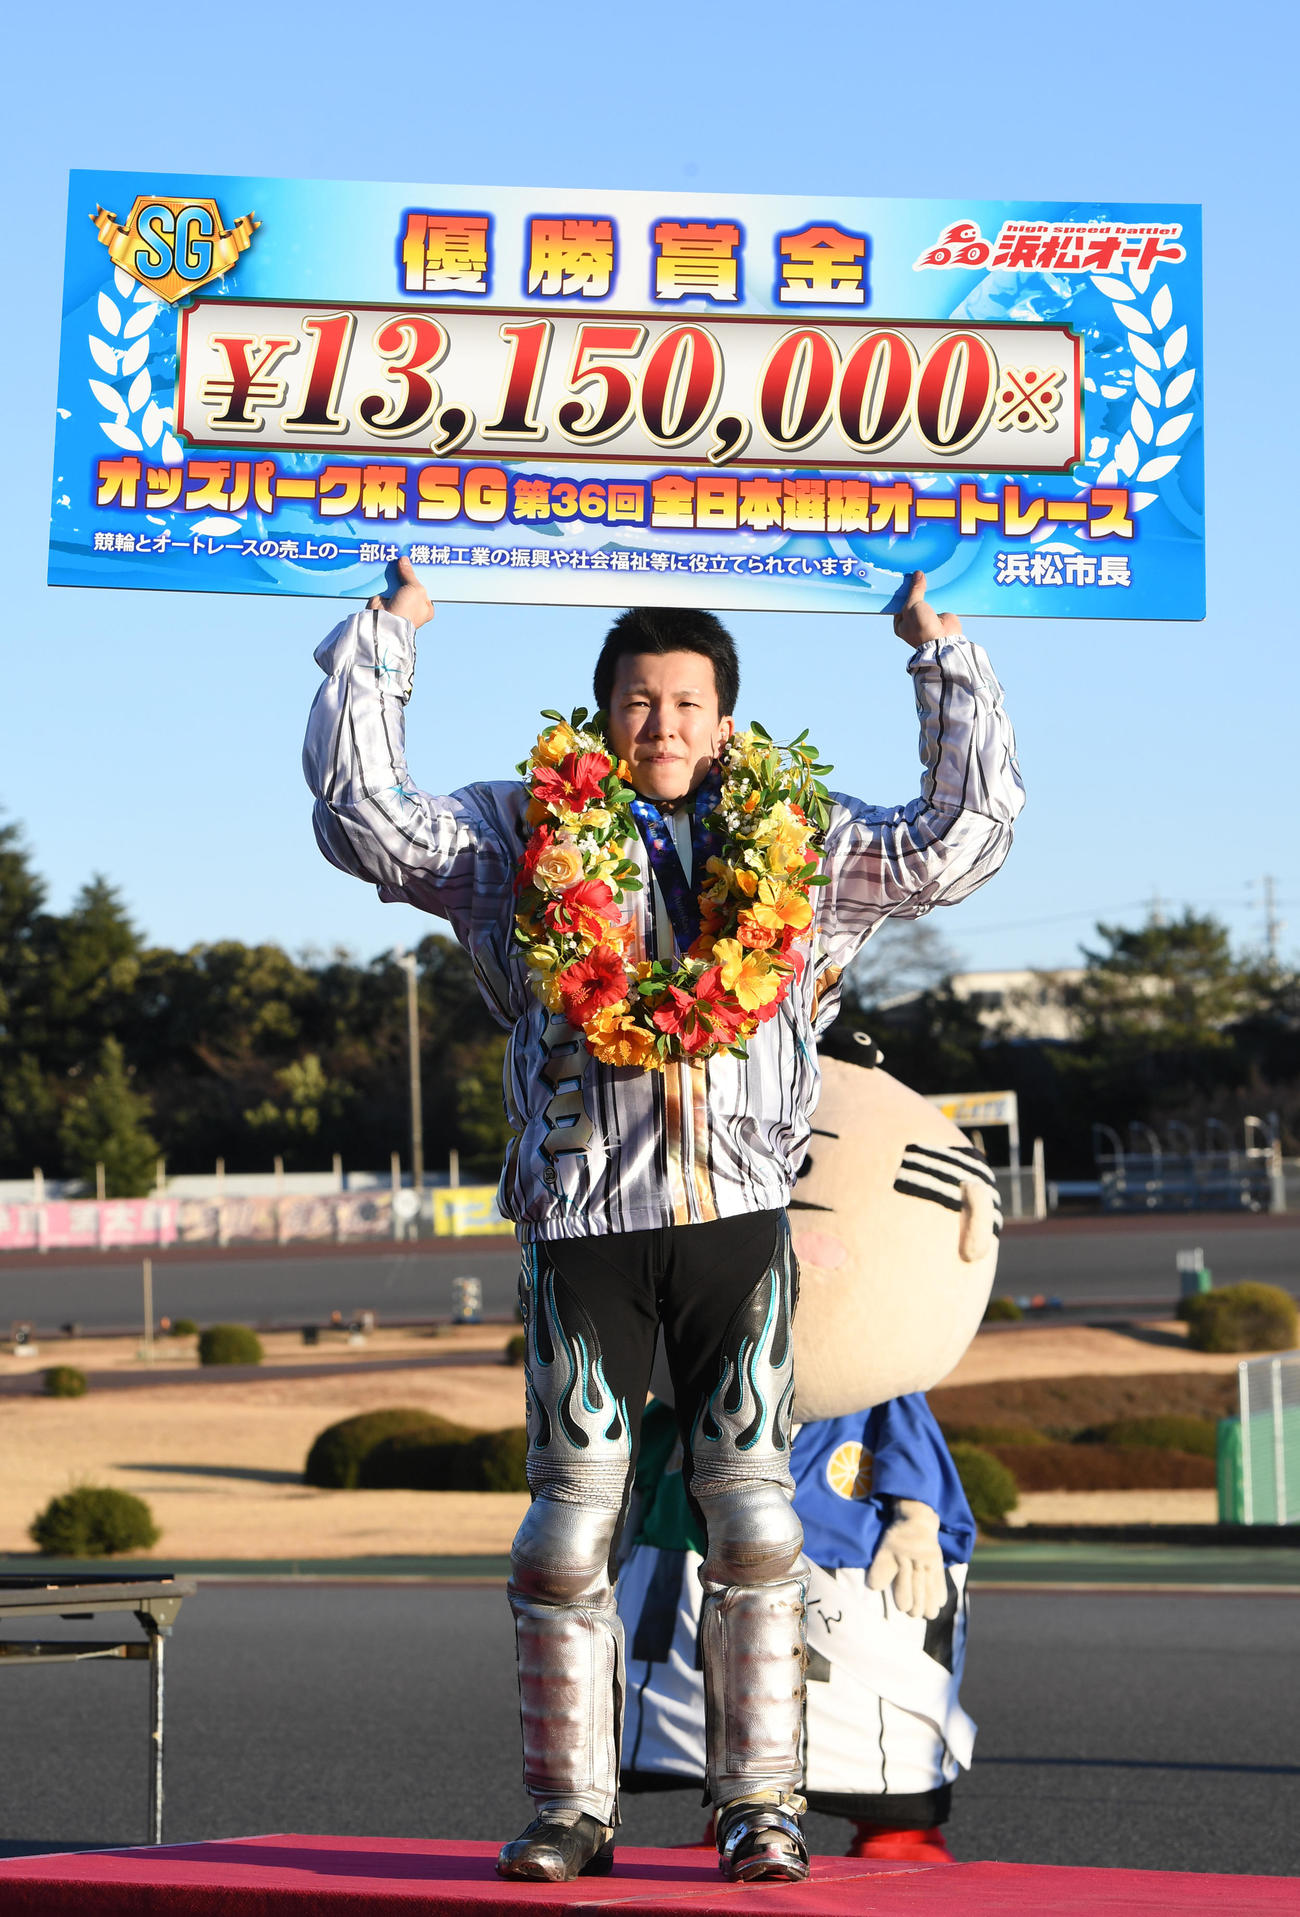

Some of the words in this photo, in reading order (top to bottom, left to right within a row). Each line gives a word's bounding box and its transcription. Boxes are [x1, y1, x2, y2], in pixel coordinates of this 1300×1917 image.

[134, 205, 215, 281] SG
[992, 234, 1182, 270] 浜松オート
[1007, 224, 1049, 233] high
[1053, 226, 1111, 234] speed
[1115, 227, 1178, 235] battle!
[402, 213, 867, 305] 優勝賞金
[97, 456, 407, 520] オッズパーク杯
[417, 465, 508, 523] SG
[513, 479, 645, 522] 第36回
[651, 474, 1134, 539] 全日本選抜オートレース
[93, 531, 868, 579] 競輪とオートレースの売上の一部は機械工業の振興や社会福祉等に役立てられています。
[996, 553, 1132, 588] 浜松市長
